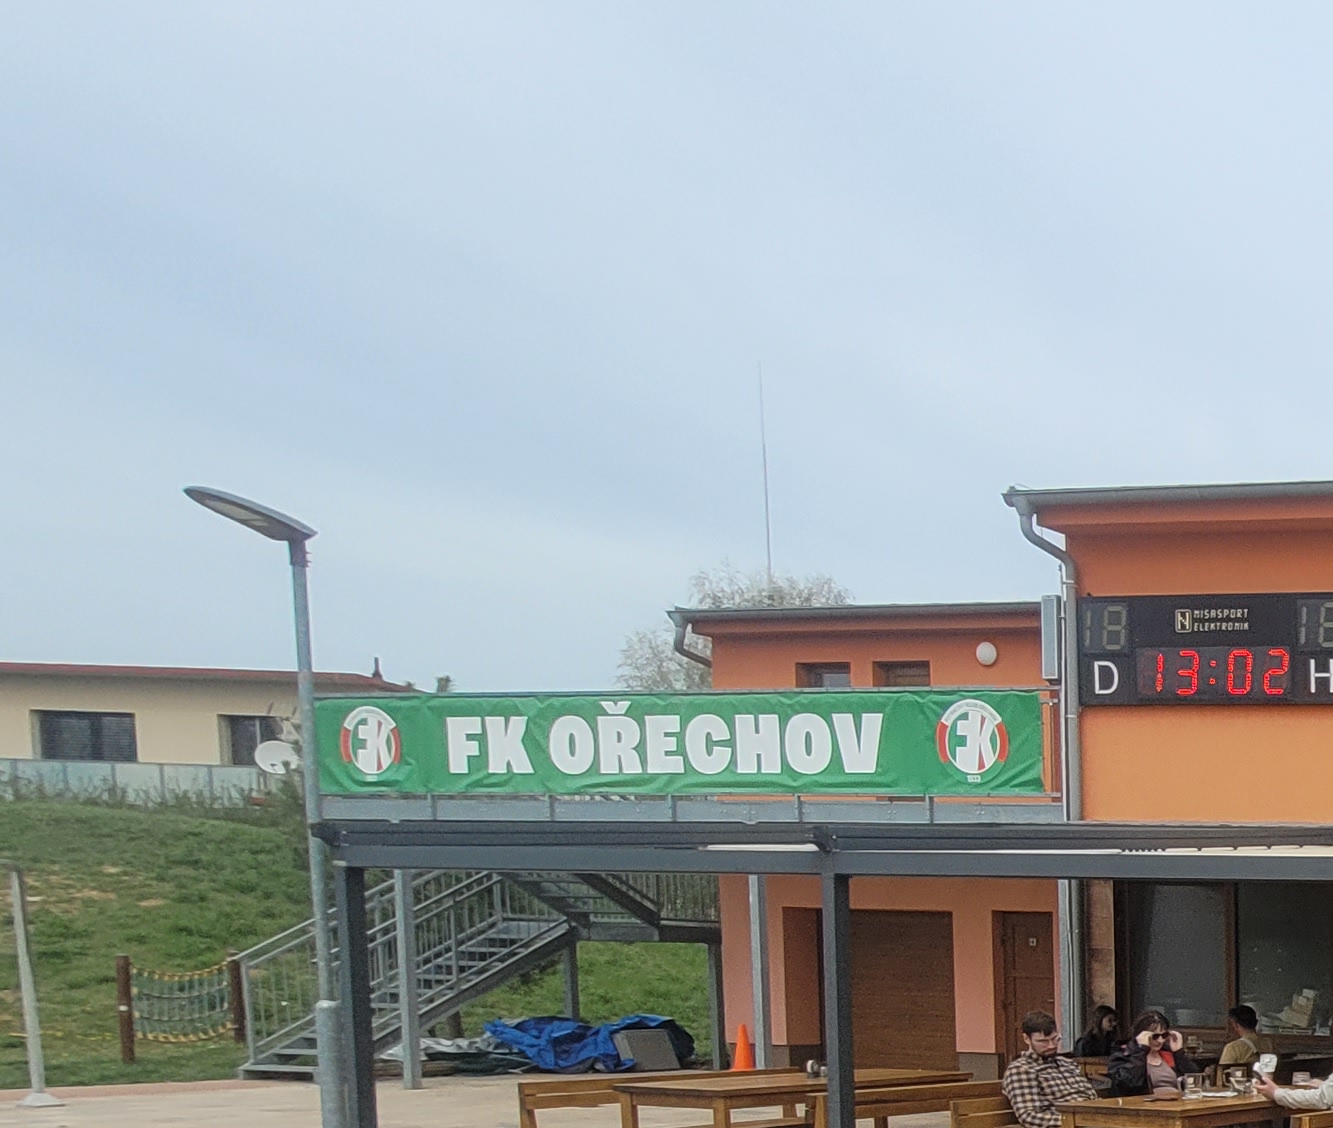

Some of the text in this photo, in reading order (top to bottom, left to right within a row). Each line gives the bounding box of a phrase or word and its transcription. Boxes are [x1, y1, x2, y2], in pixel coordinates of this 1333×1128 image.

[1193, 622, 1249, 632] ELEKTRONIK
[1094, 660, 1119, 695] D
[1155, 648, 1290, 695] 13:02
[446, 716, 535, 774] FK
[549, 700, 884, 775] OŘECHOV
